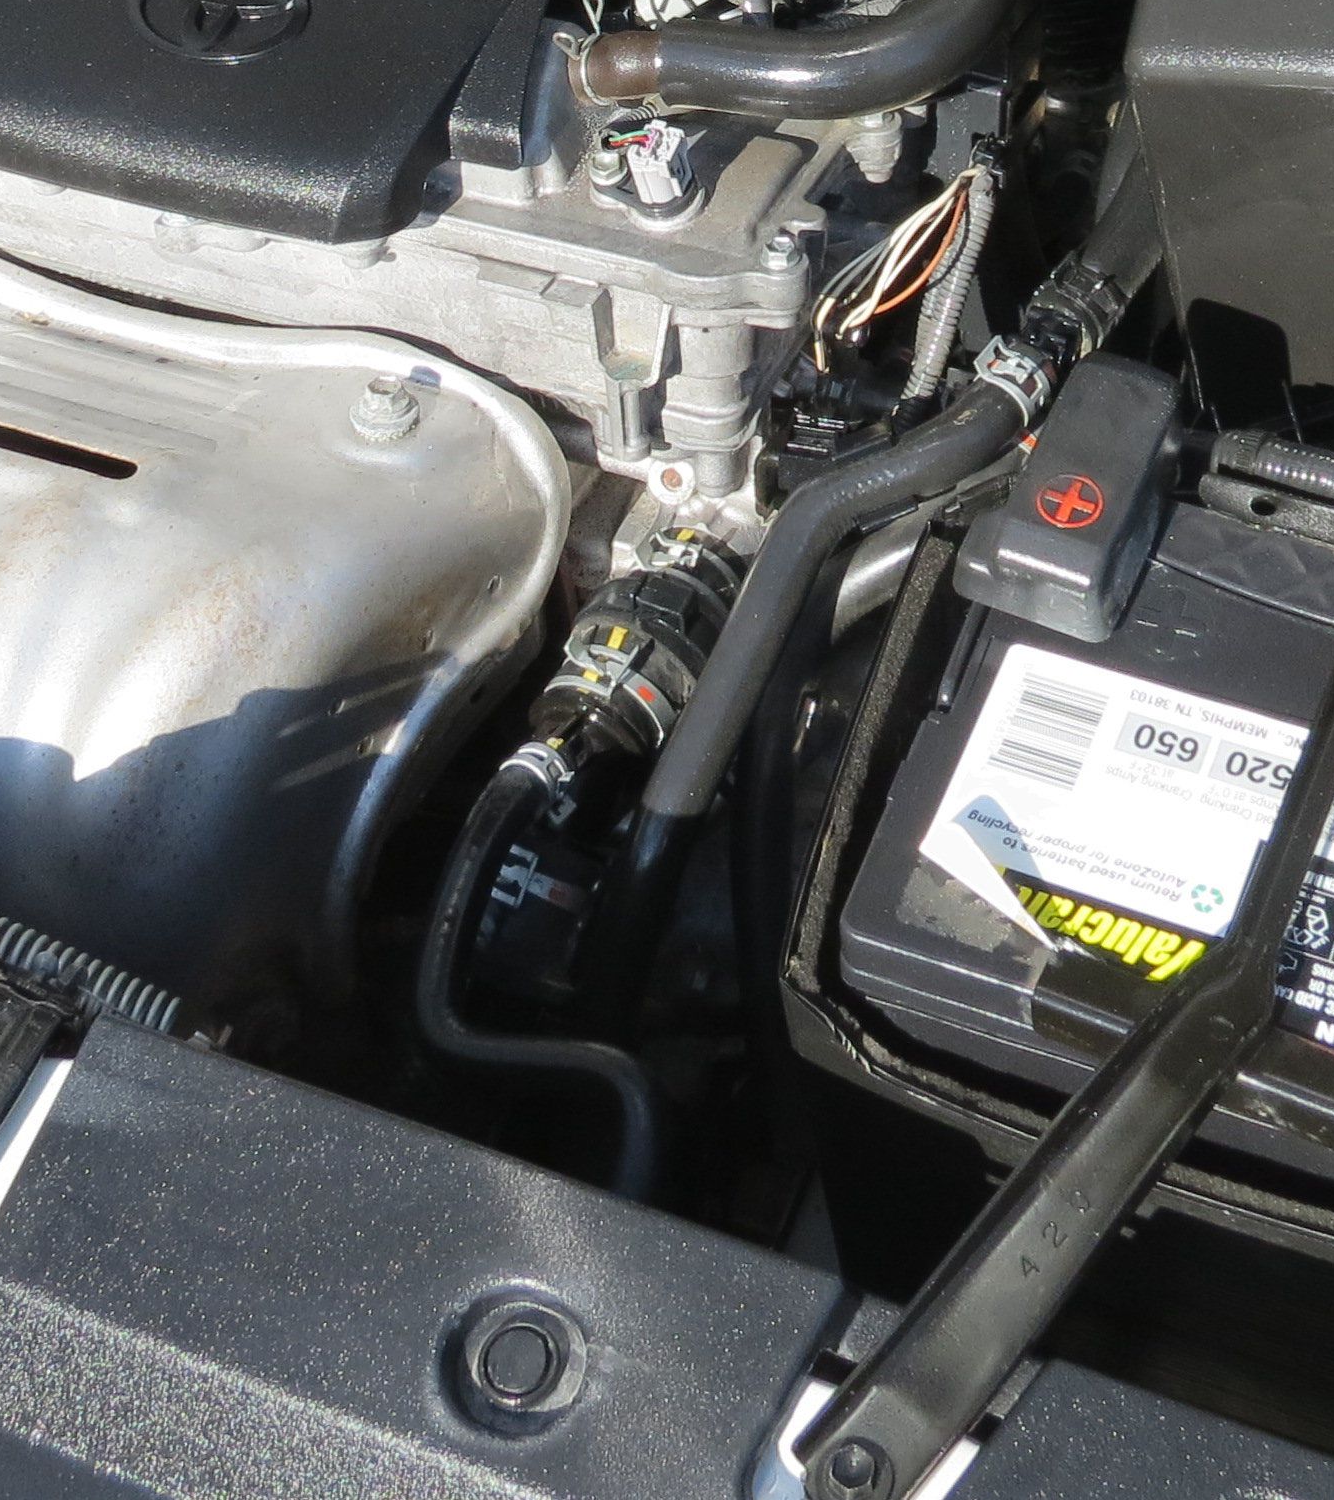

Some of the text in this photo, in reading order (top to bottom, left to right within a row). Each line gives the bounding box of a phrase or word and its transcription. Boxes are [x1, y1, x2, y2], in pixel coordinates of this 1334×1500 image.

[1127, 687, 1308, 751] NC., MEMPHIS, TN 38103
[1128, 720, 1204, 765] 650
[1102, 761, 1196, 801] Cranking Amps
[1158, 766, 1175, 780] at
[1220, 747, 1296, 792] 520
[1196, 791, 1278, 827] old Cranking
[964, 808, 1188, 889] AutoZone for proper recycling
[999, 836, 1183, 903] Return used batteries to
[1291, 988, 1326, 1012] ACID
[1306, 977, 1327, 995] OR
